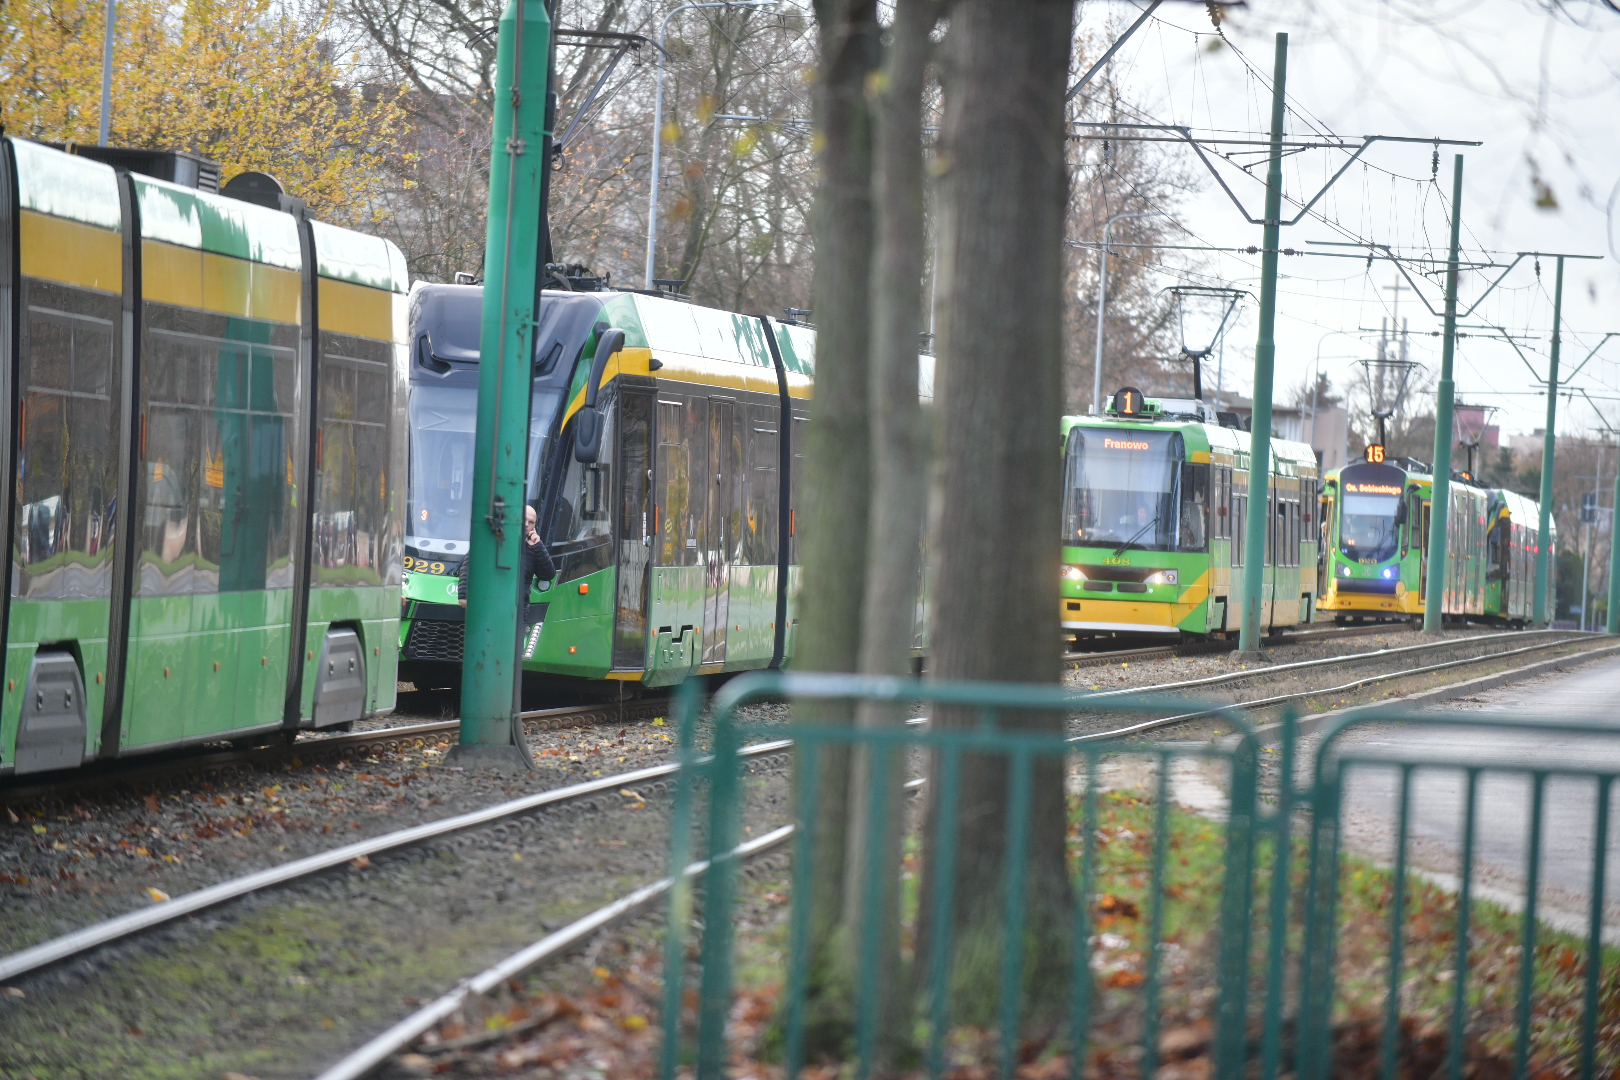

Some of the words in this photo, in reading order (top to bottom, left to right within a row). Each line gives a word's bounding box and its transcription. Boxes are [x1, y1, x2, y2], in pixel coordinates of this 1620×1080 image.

[1123, 391, 1133, 414] 1
[1104, 438, 1149, 450] Franowo
[1367, 445, 1384, 463] 15
[403, 556, 446, 575] 929
[1102, 557, 1131, 566] 408
